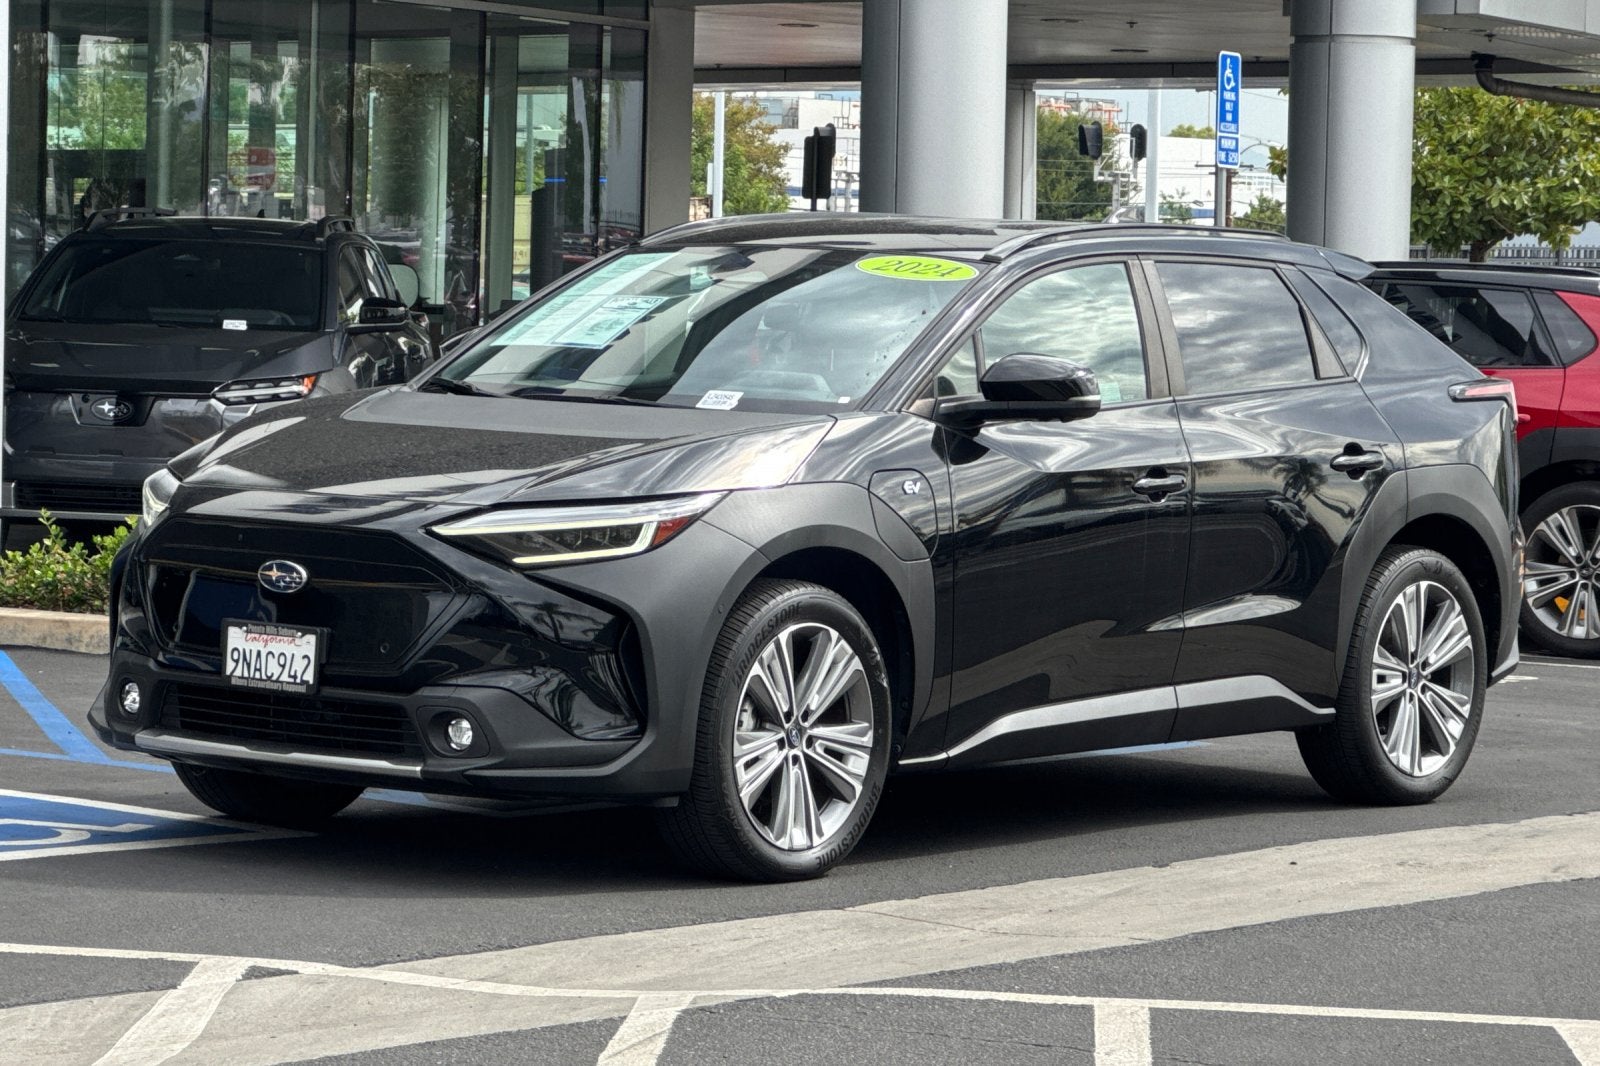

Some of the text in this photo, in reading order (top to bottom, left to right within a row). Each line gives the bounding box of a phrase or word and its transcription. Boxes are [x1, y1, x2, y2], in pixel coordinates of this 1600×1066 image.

[1223, 90, 1236, 101] PARKING
[1225, 102, 1233, 111] ONLY
[1221, 138, 1236, 149] MINIMUM
[1218, 151, 1226, 162] FINE
[872, 259, 963, 278] 2024
[903, 480, 921, 494] EV
[245, 631, 302, 648] California
[229, 647, 311, 686] 9NAC942
[815, 781, 881, 871] BRIDGESTONE
